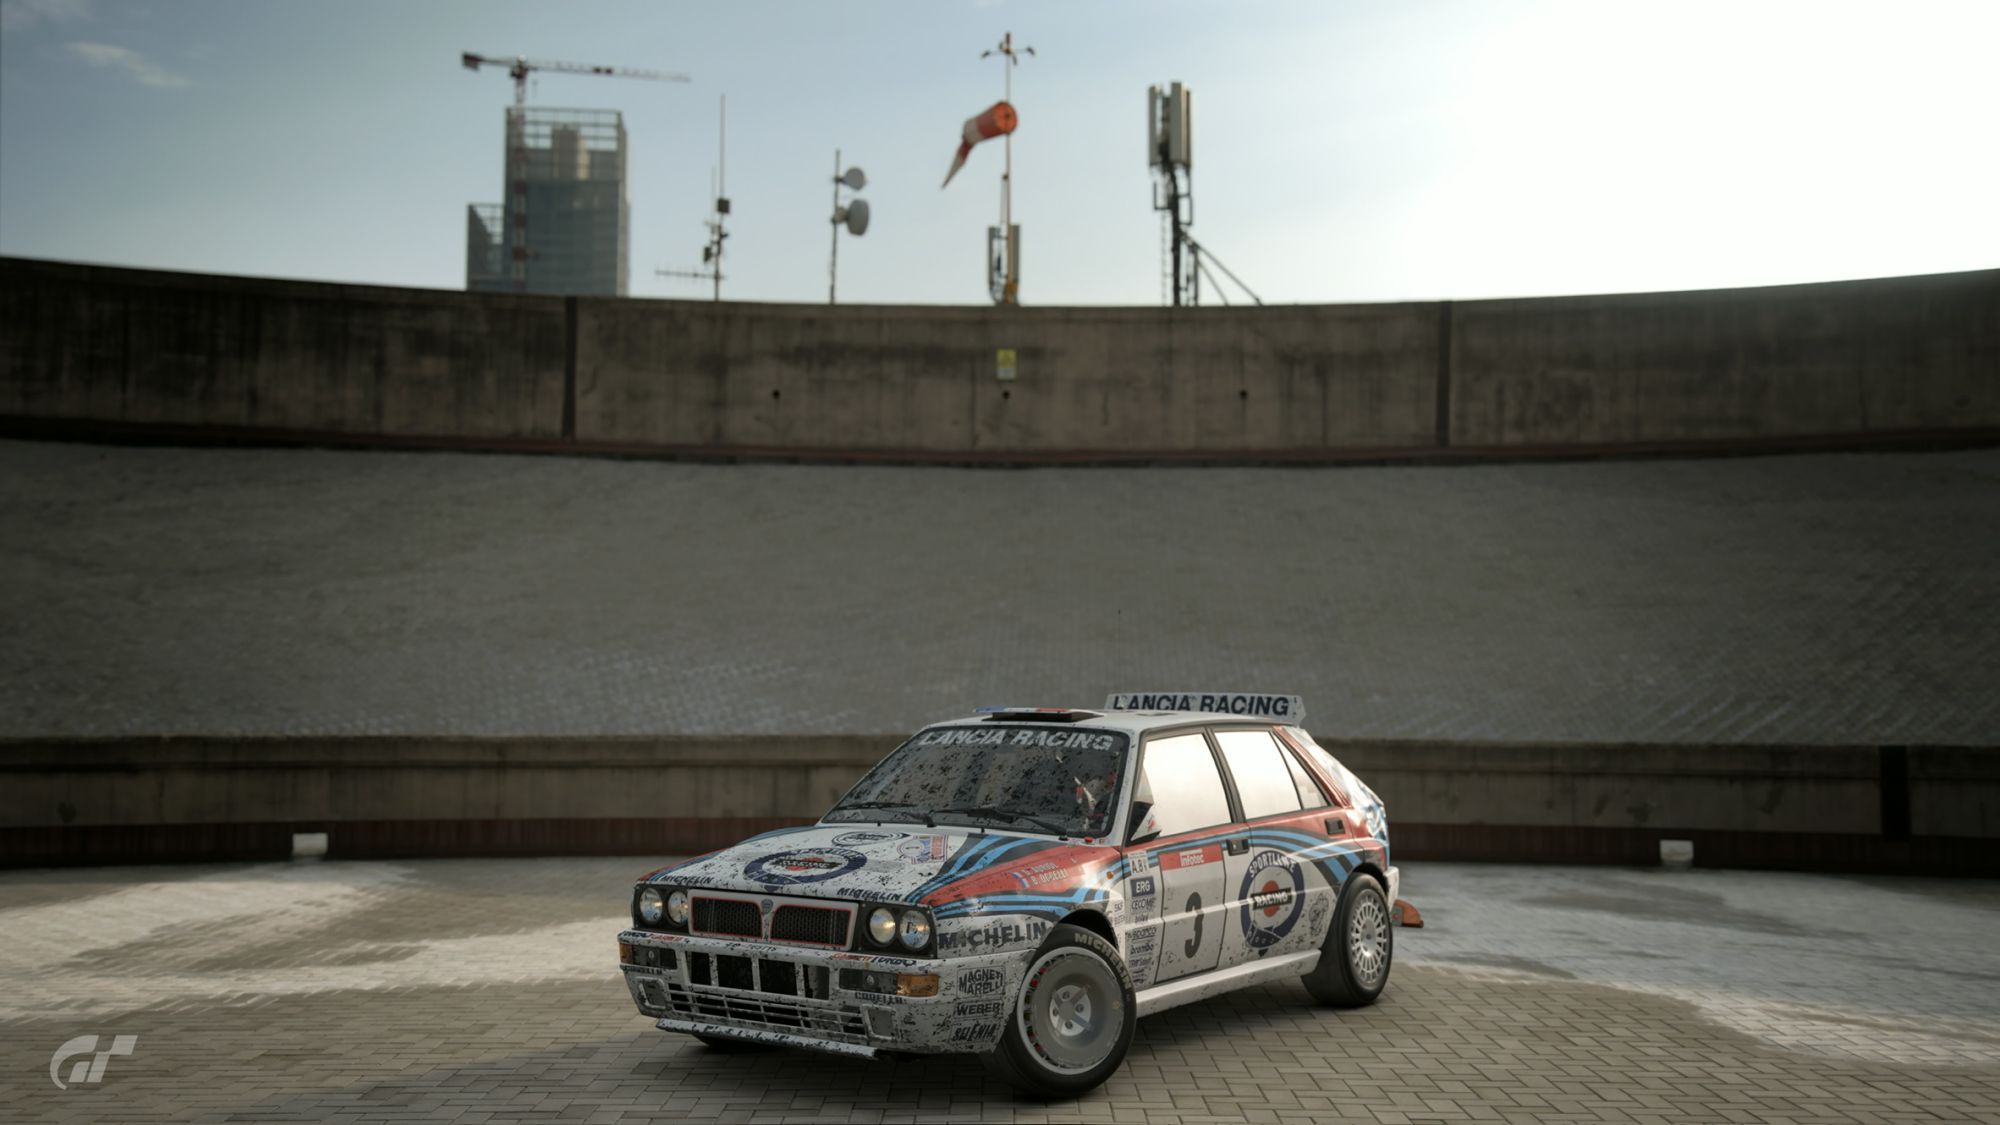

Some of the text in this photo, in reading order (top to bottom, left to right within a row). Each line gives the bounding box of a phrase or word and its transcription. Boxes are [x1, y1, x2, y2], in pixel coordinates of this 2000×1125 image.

[1113, 694, 1290, 716] LANCIA RACING
[918, 730, 1114, 751] LANCIA RACING
[1249, 851, 1297, 878] SPORTLINE
[836, 886, 902, 901] MICHELIN
[1135, 881, 1151, 893] ERG
[1254, 890, 1289, 908] RACING
[1184, 891, 1205, 959] 3
[938, 921, 1047, 949] MICHELIN
[1074, 932, 1133, 990] MICHELIN
[959, 969, 1003, 987] MAGNETI
[959, 979, 1003, 995] MARELLI
[956, 1003, 1001, 1016] WEBER
